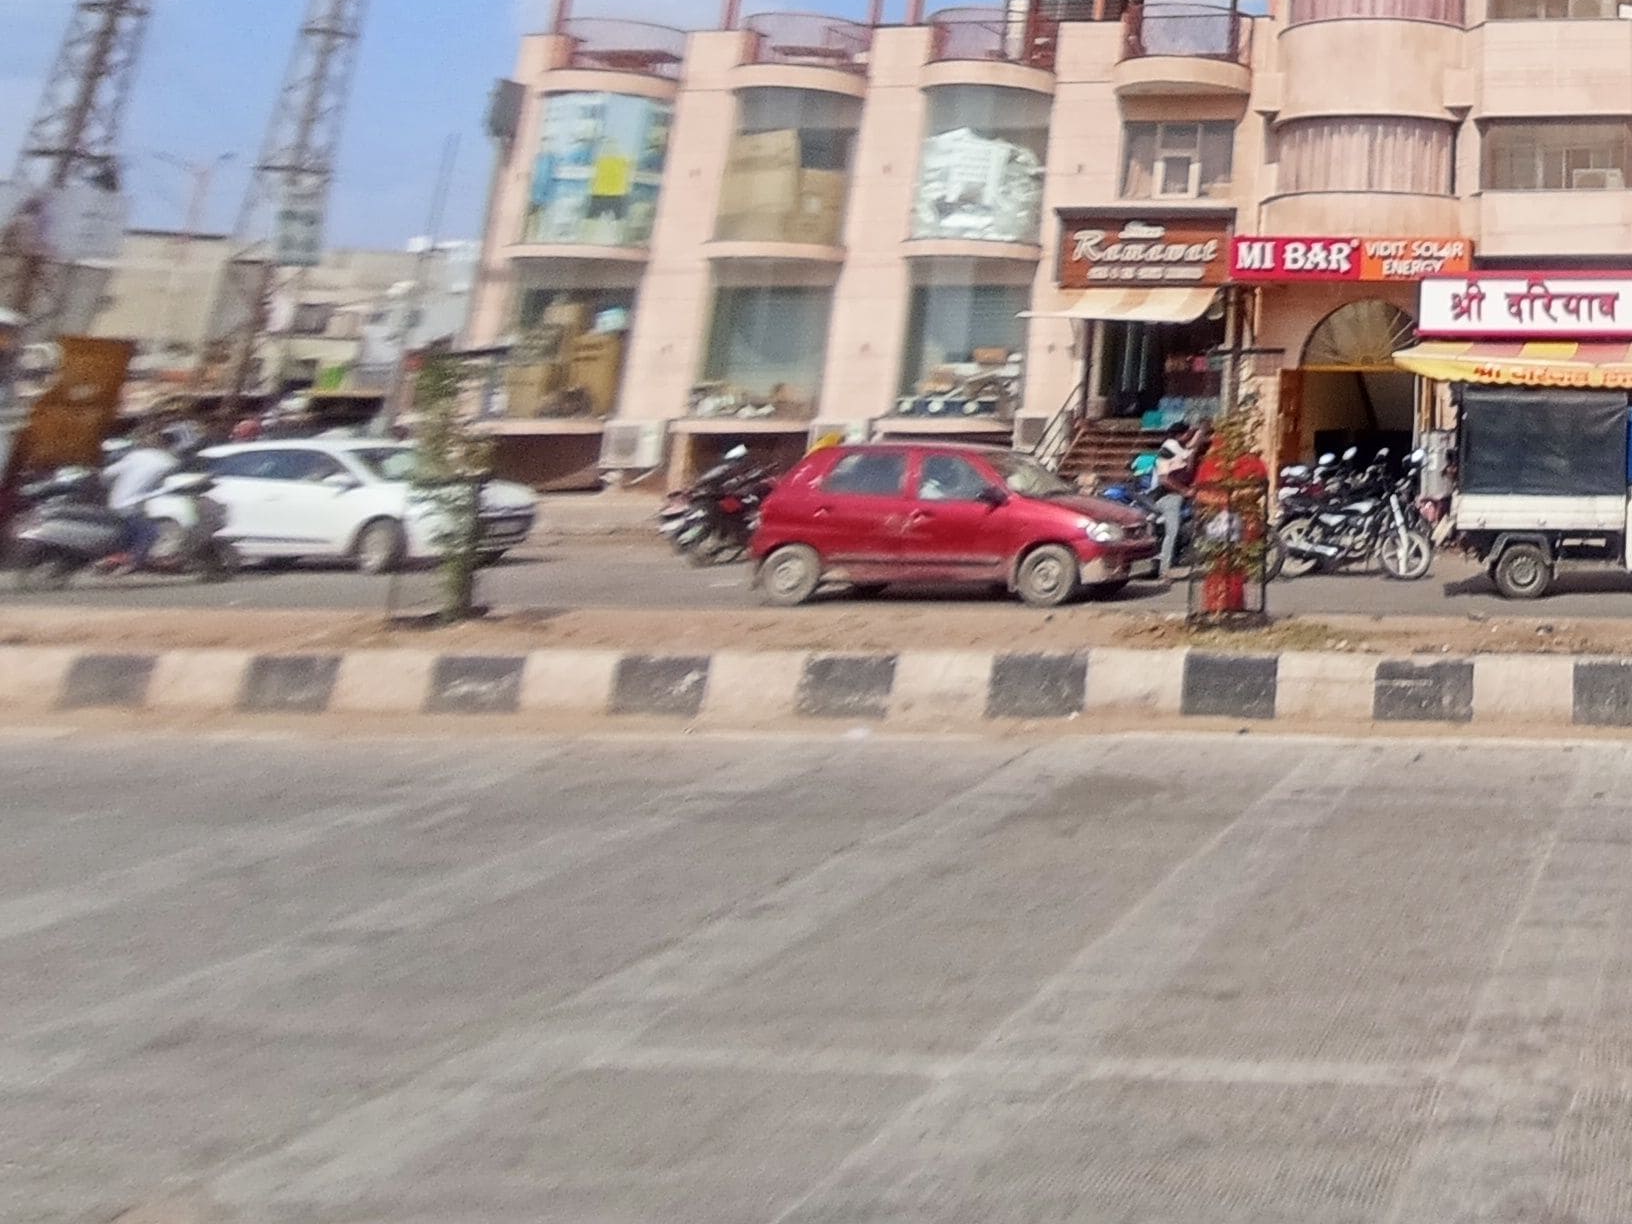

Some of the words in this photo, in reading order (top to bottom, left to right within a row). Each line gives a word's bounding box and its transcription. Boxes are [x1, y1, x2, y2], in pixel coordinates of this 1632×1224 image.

[1072, 229, 1218, 262] Ramawat
[1235, 241, 1276, 270] MI
[1283, 241, 1352, 273] BAR
[1364, 241, 1407, 257] VIDIT
[1411, 241, 1464, 257] SOLAR
[1383, 259, 1445, 275] ENERGY
[1452, 278, 1486, 322] श्री
[1505, 278, 1619, 323] दरियाव
